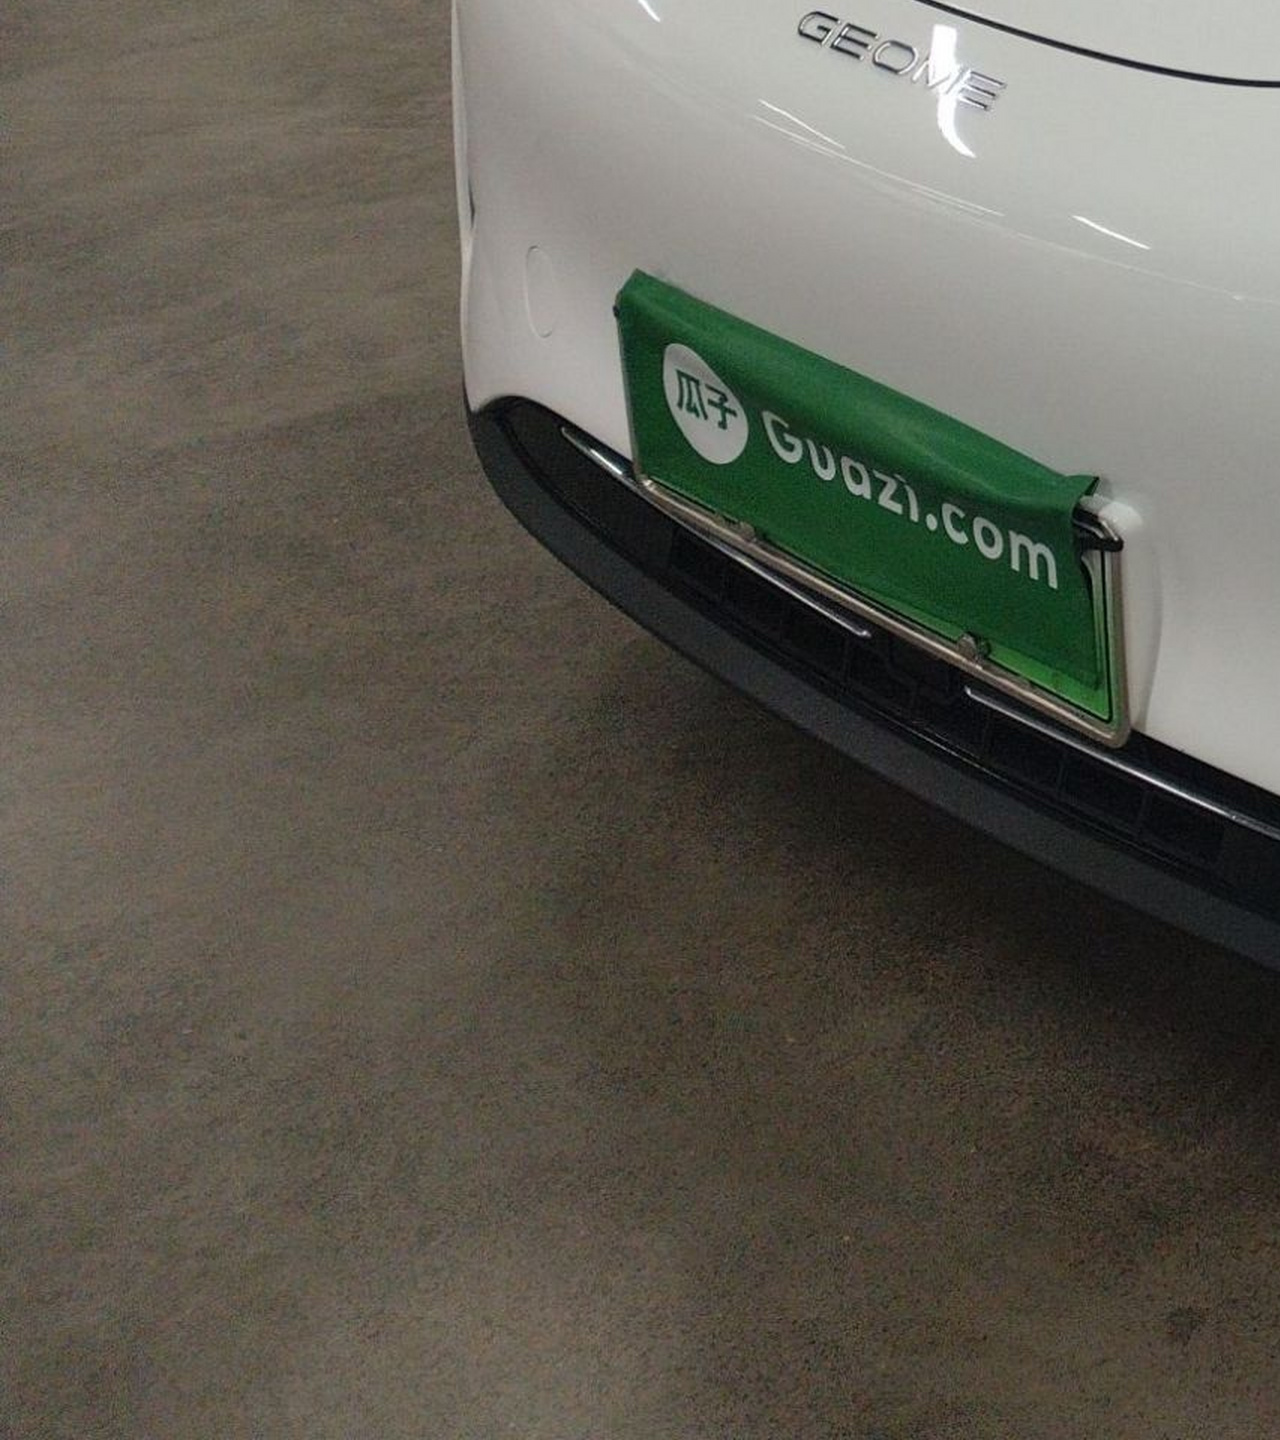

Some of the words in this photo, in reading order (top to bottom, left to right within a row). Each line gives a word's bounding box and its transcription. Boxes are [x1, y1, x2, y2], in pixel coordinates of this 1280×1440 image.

[797, 10, 1008, 111] GEOME
[676, 369, 738, 431] 瓜子
[762, 410, 1059, 591] Guazi.com
